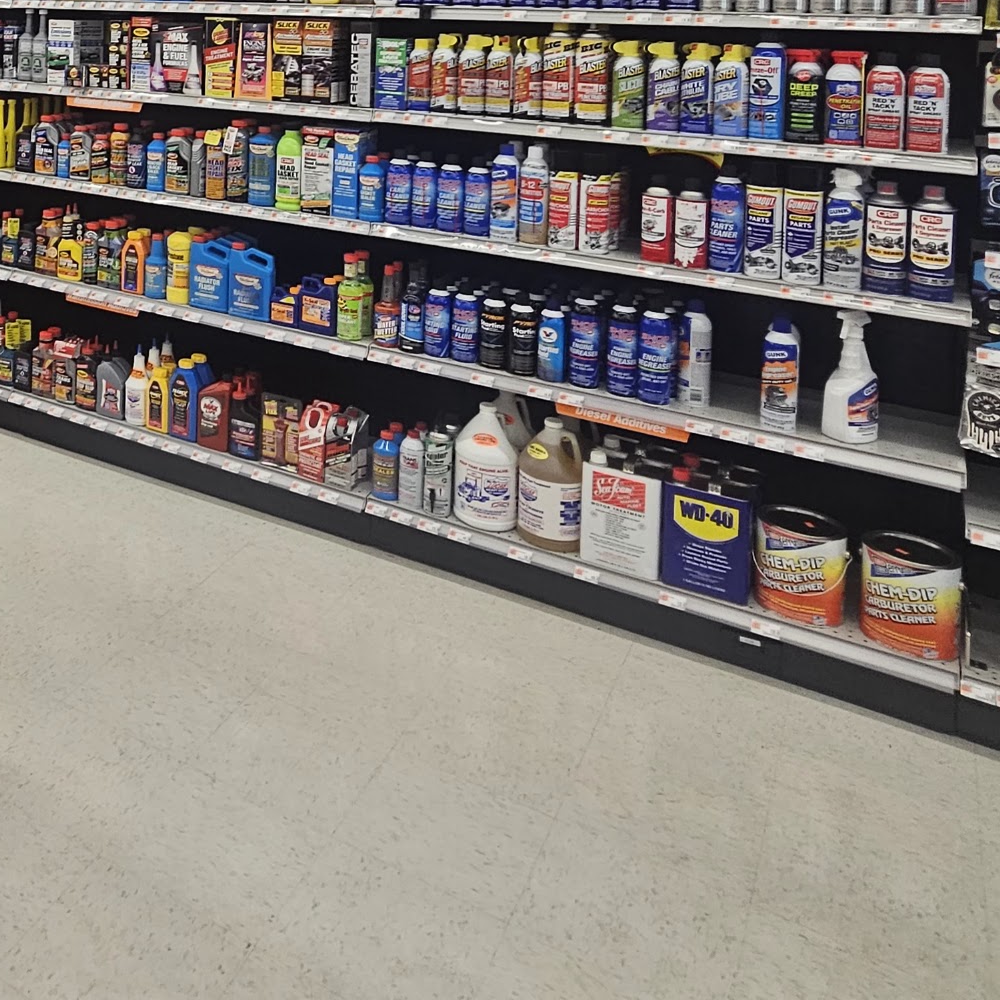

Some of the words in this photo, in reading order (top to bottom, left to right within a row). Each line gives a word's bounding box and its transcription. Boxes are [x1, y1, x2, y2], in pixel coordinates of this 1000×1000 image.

[163, 43, 189, 52] ENGINE
[170, 52, 188, 61] FUEL
[753, 58, 771, 66] CRC
[351, 33, 359, 106] CERATEC
[790, 83, 818, 91] DEEP
[878, 210, 898, 218] CRC
[920, 215, 942, 224] CRC
[750, 216, 770, 224] PARTS
[710, 222, 734, 231] PARTS
[575, 406, 611, 422] Diesel
[614, 414, 666, 435] Additives
[679, 499, 733, 530] WD-40
[759, 552, 826, 571] CHEM-DIP
[761, 569, 825, 582] CARBURETOR
[865, 580, 937, 601] CHEM-DIP
[865, 596, 937, 614] CARBURETOR
[865, 606, 893, 620] PARTS
[894, 614, 937, 625] CLEANER
